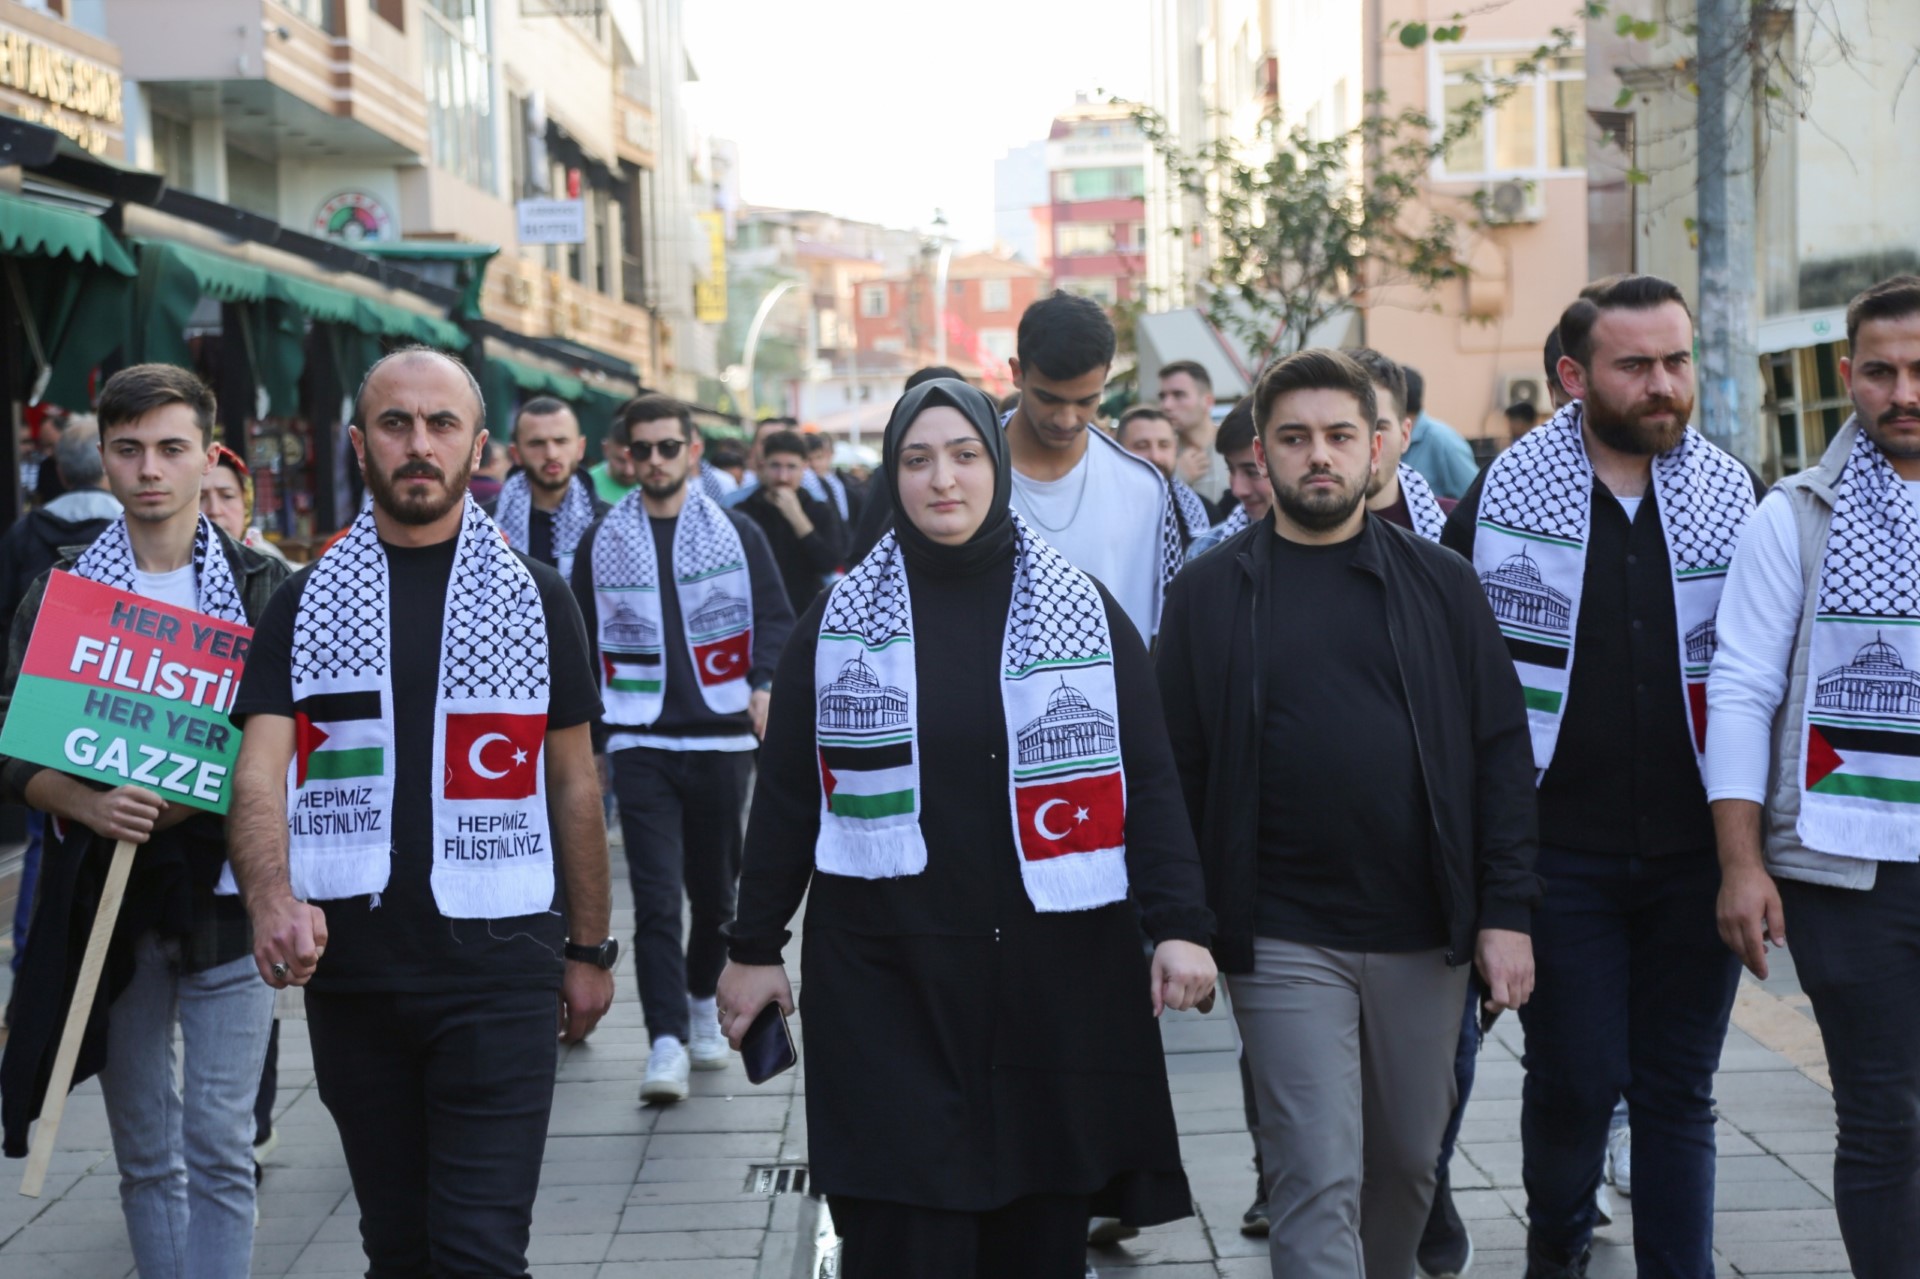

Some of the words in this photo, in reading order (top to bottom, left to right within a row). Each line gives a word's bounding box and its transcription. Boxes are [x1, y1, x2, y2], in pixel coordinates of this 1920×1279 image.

[110, 600, 181, 644] HER
[191, 621, 251, 663] YER
[83, 688, 155, 732] HER
[165, 709, 231, 753] YER
[63, 727, 227, 802] GAZZE
[296, 785, 373, 809] HEPİMİZ
[458, 810, 529, 833] HEPİMİZ
[444, 831, 544, 861] FİLİSTİNLİYİZ
